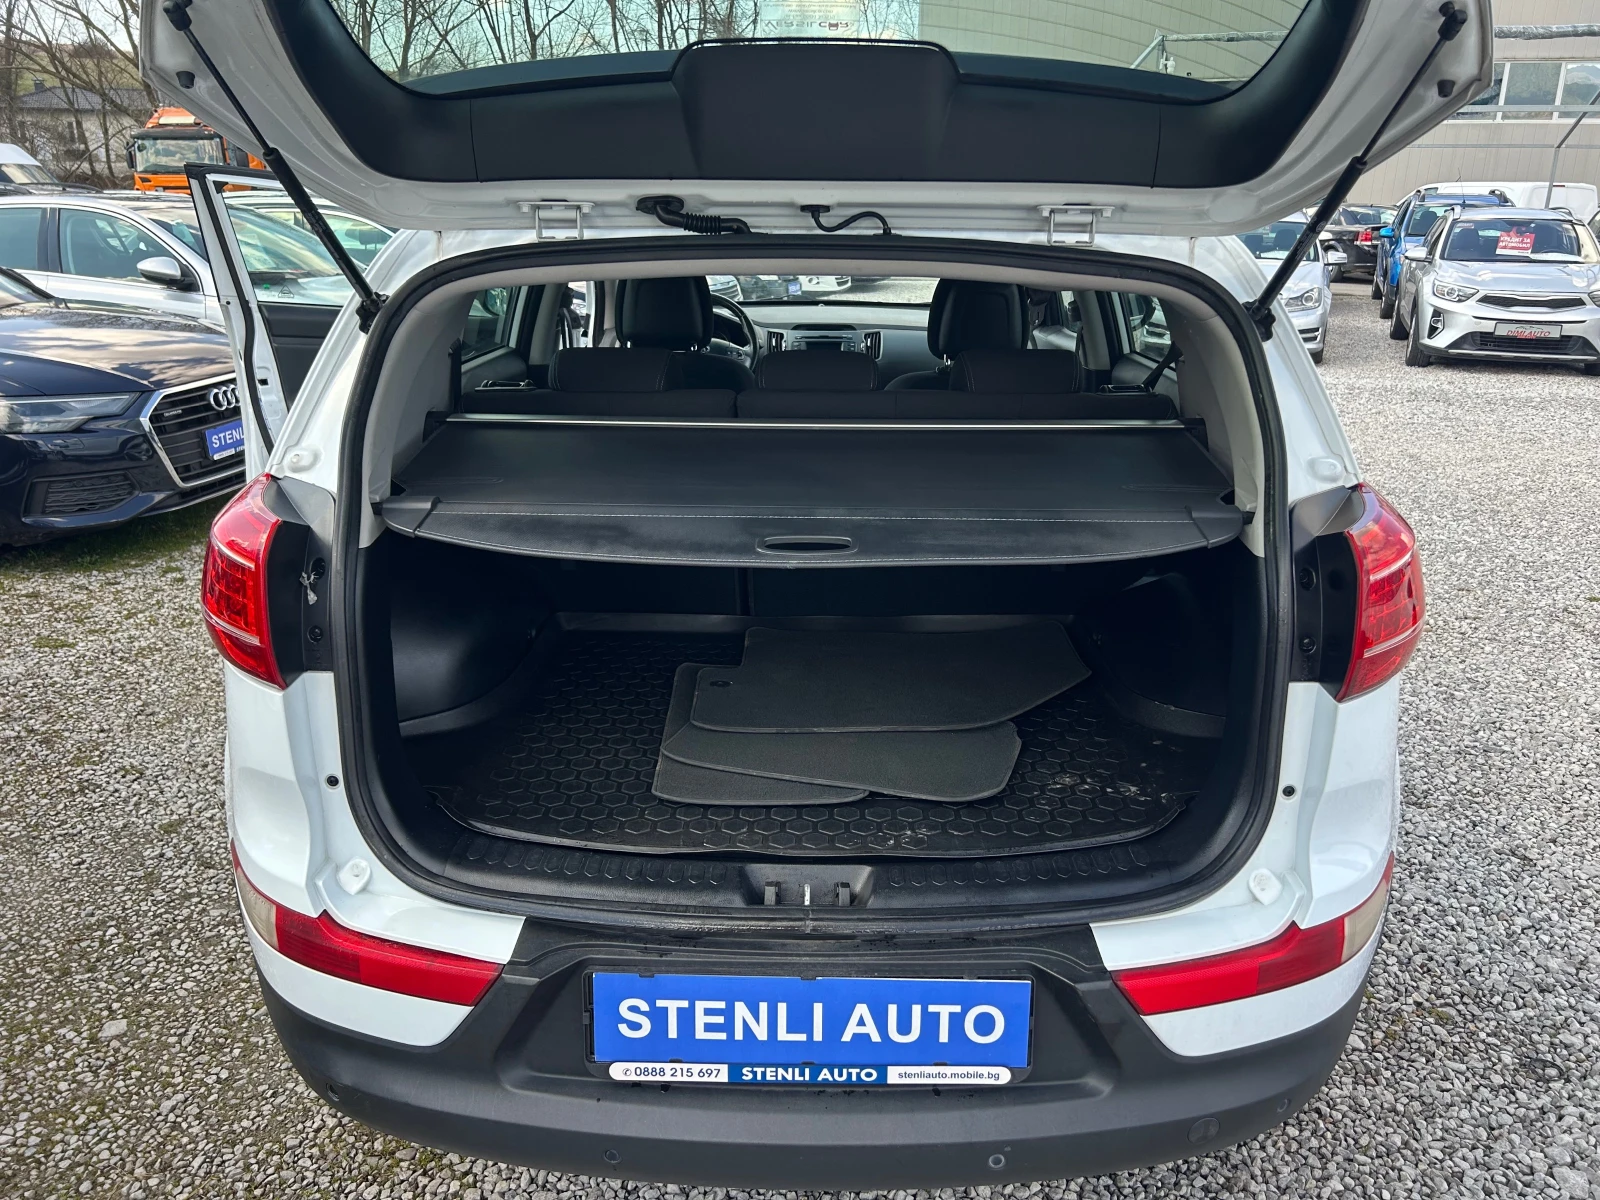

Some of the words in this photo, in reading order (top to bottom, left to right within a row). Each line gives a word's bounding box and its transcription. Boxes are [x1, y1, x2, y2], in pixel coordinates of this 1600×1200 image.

[212, 427, 245, 448] STENL
[617, 998, 823, 1042] STENLI
[840, 1002, 1006, 1044] AUTO
[634, 1066, 666, 1077] 0888
[669, 1067, 694, 1078] 215
[697, 1068, 721, 1079] 697
[741, 1066, 810, 1081] STENLI
[817, 1068, 878, 1082] AUTO
[897, 1070, 1000, 1081] stenliauto.mobile.bg
